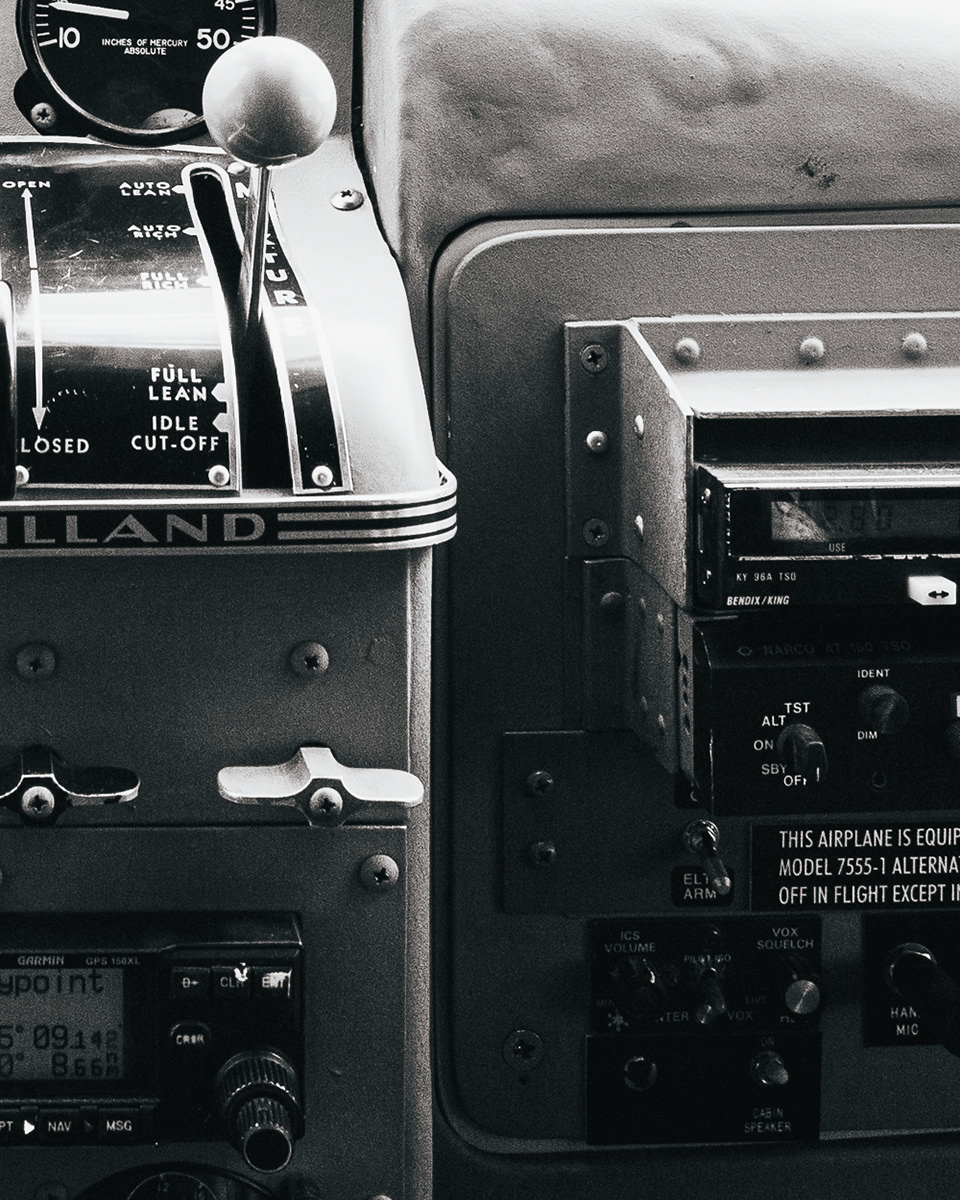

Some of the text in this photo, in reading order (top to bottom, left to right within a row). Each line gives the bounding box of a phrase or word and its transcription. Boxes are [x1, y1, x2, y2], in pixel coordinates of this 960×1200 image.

[58, 27, 80, 49] 10
[101, 38, 132, 47] INCHES
[149, 39, 188, 47] MERCURY
[196, 28, 230, 50] 50
[123, 47, 167, 55] ABSOLUTE
[2, 180, 52, 189] OPEN
[118, 181, 170, 190] AUTO
[120, 188, 171, 197] LEAN
[127, 224, 182, 233] AUTO
[133, 230, 178, 239] RICH
[140, 272, 188, 282] FULL
[142, 281, 190, 290] RICH
[150, 367, 202, 384] FULL
[148, 385, 207, 402] LEAN
[151, 416, 198, 431] IDLE
[20, 437, 90, 454] LOSED
[131, 435, 220, 452] CUT-OFF
[828, 543, 846, 552] USE
[736, 572, 797, 582] KY 96A TSO
[726, 596, 790, 606] BENDIX/KING
[857, 669, 890, 678] IDENT
[784, 702, 811, 714] TST
[761, 715, 786, 727] ALT
[857, 731, 878, 740] DIM
[753, 740, 774, 751] ON
[761, 764, 787, 775] SBY
[779, 829, 813, 848] THIS
[817, 829, 893, 848] AIRPLANE
[898, 828, 911, 847] IS
[779, 856, 960, 877] MODEL 7555-1 ALTERNA
[683, 888, 717, 900] ARM
[779, 883, 946, 906] OFF IN FLIGHT EXCEPT
[620, 931, 640, 941] ICS
[772, 928, 798, 938] VOX
[604, 942, 656, 954] VOLUME
[757, 938, 814, 950] SQUELCH
[17, 956, 65, 966] GARMIN
[85, 957, 108, 965] GPS
[896, 1024, 919, 1035] MIC
[753, 1107, 784, 1118] CABIN
[47, 1121, 72, 1133] NAV
[105, 1120, 133, 1132] MSG
[743, 1121, 792, 1134] SPEAKER
